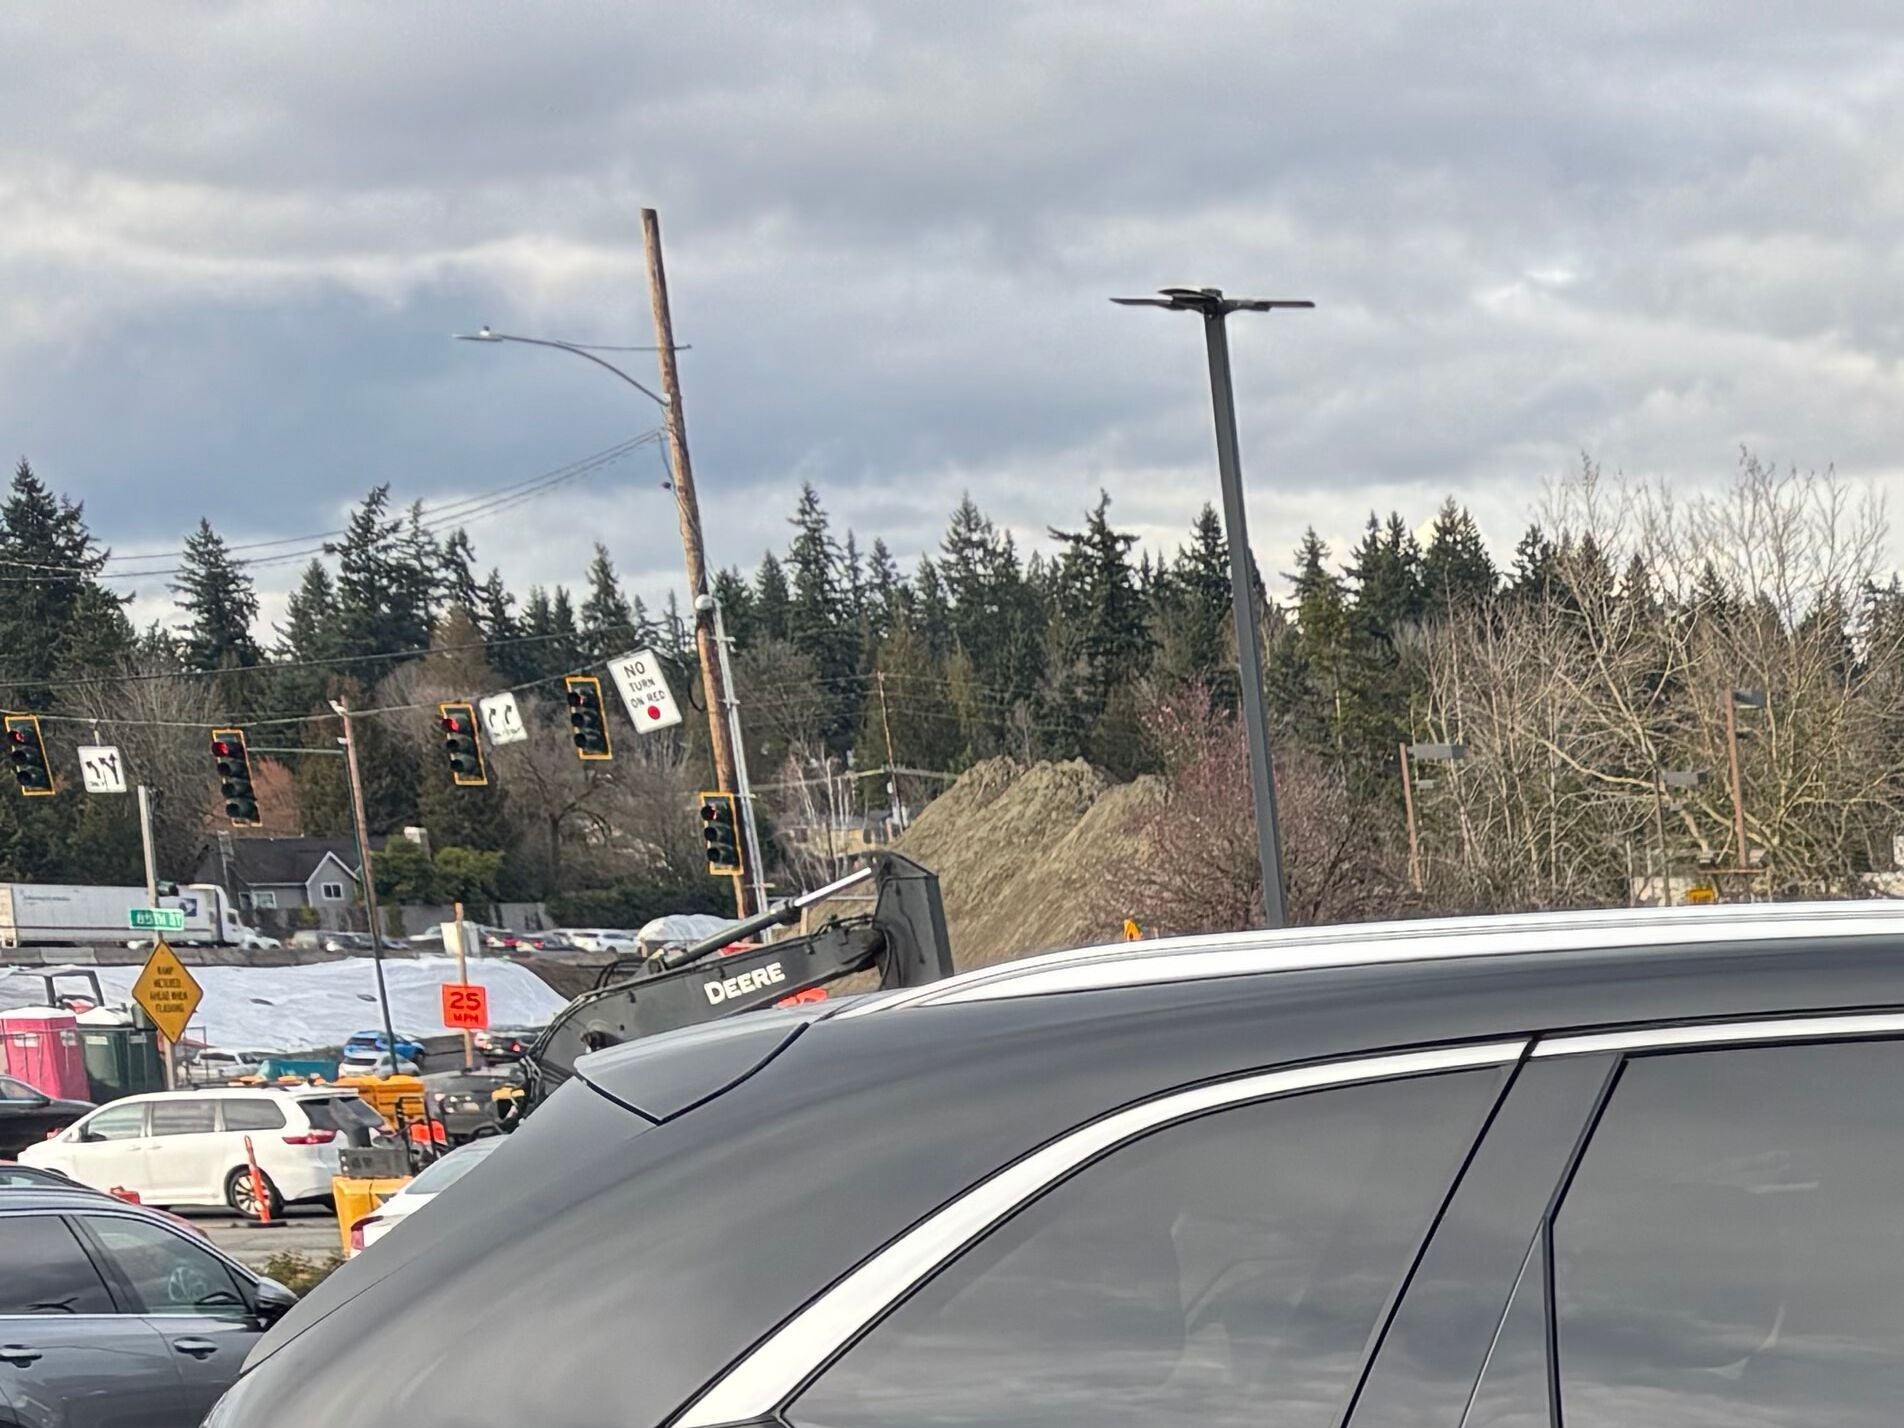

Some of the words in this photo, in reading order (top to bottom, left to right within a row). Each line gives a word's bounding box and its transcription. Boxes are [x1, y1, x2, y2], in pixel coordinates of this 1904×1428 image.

[623, 661, 646, 678] NO
[628, 678, 656, 692] TURN
[630, 697, 645, 709] ON
[646, 690, 666, 702] RED
[703, 961, 786, 1005] DEERE
[450, 991, 481, 1011] 25
